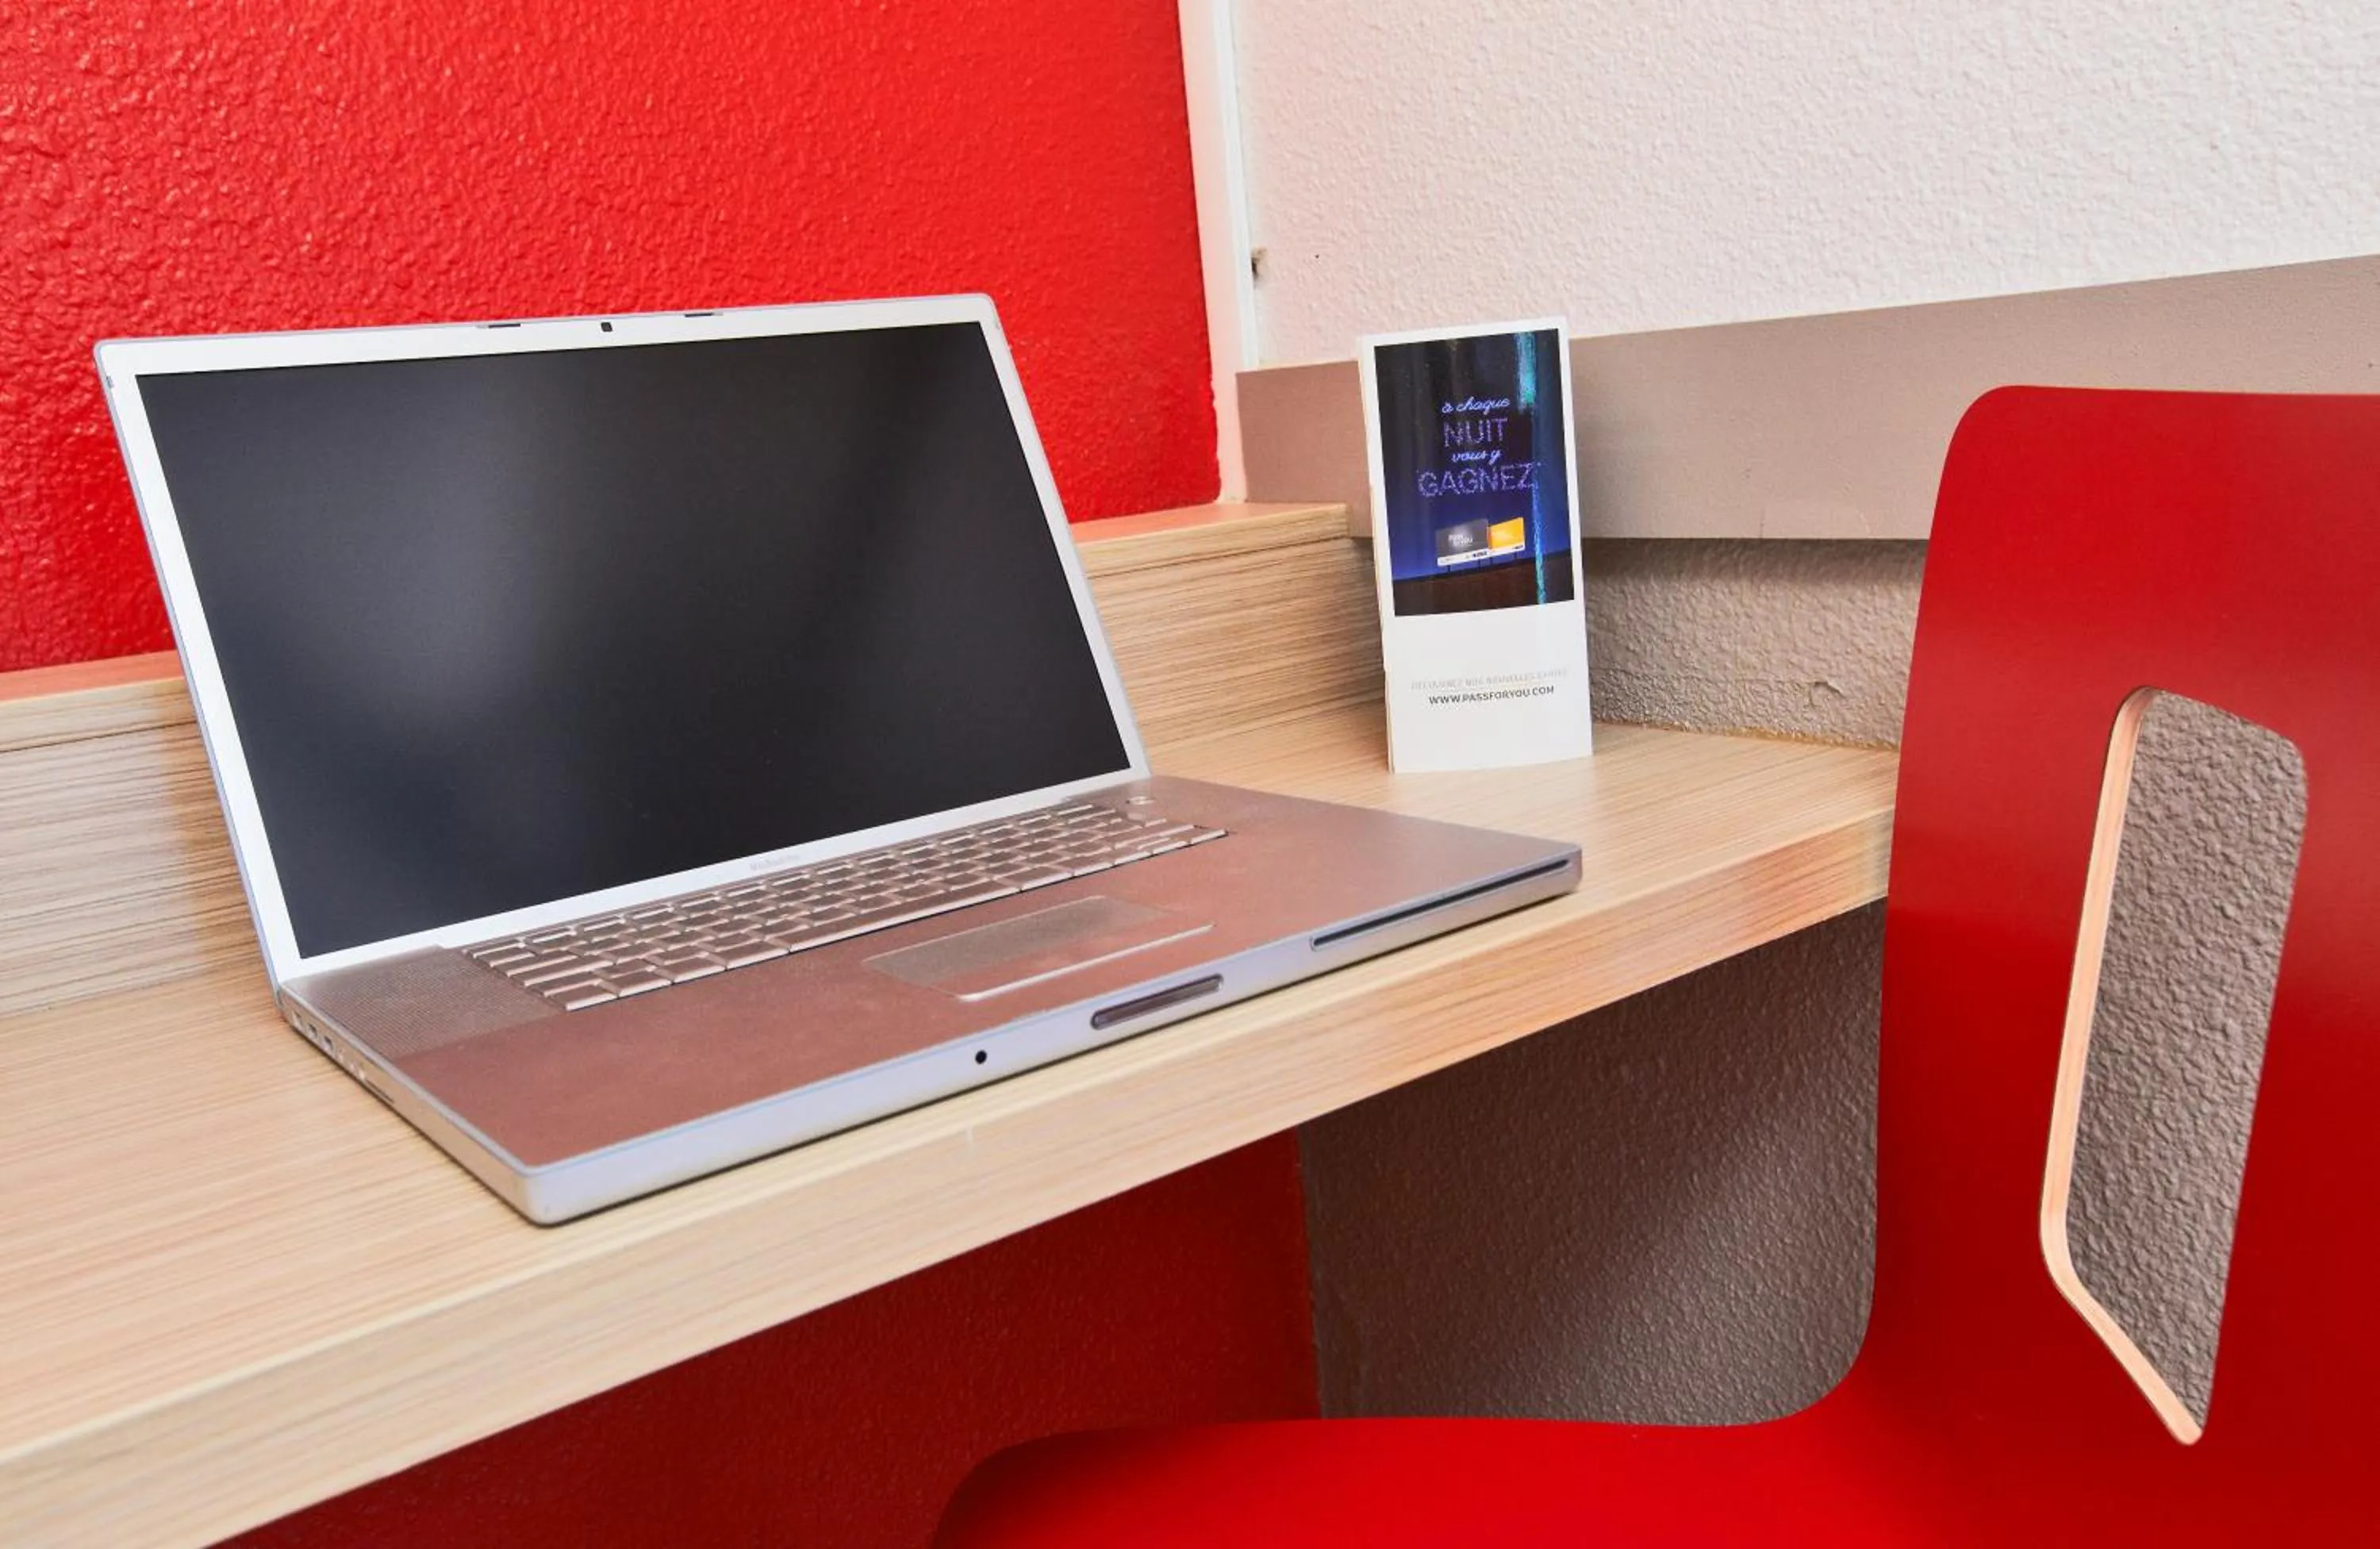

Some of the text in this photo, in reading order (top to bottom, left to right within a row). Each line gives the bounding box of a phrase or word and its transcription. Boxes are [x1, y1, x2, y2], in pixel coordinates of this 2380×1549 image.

[1457, 396, 1511, 415] chaque
[1444, 419, 1508, 447] NUIT
[1452, 450, 1501, 465] vous y
[1418, 463, 1534, 498] GAGNEZ
[1428, 685, 1555, 705] WWW.PASSFORYOU.COM
